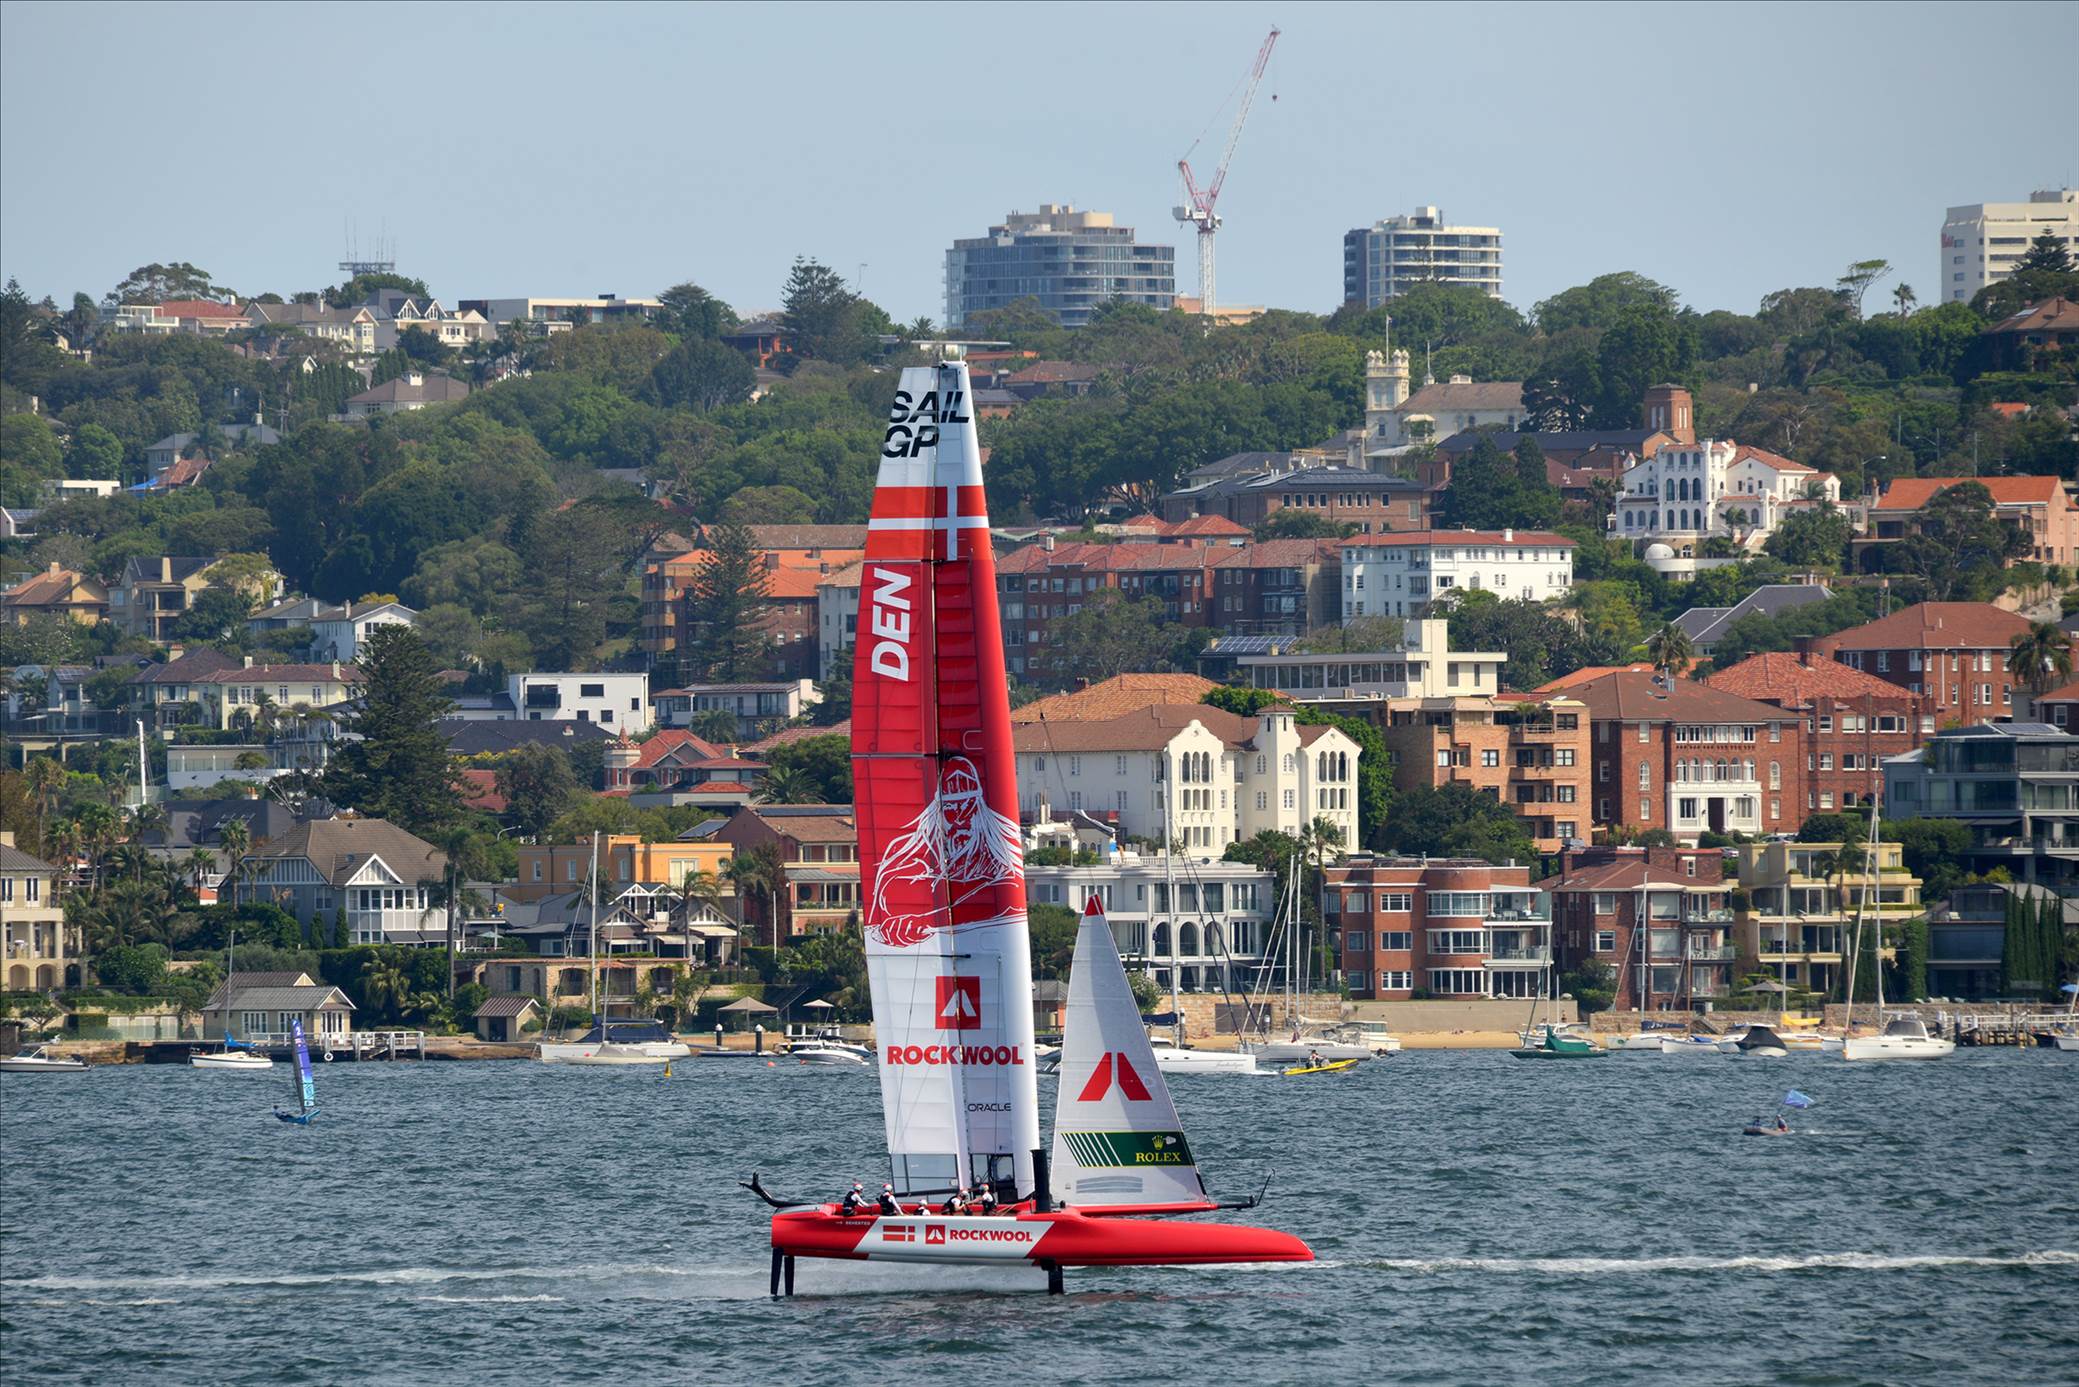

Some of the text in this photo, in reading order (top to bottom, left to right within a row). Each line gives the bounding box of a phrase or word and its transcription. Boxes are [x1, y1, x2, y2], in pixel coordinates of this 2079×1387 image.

[889, 391, 969, 423] SAIL
[882, 425, 940, 458] GP
[871, 567, 911, 681] DEN
[887, 1045, 1024, 1065] ROCKWOOL
[967, 1103, 1012, 1112] ORACLE
[1135, 1152, 1181, 1162] ROLEX
[949, 1229, 1033, 1242] ROCKWOOL
